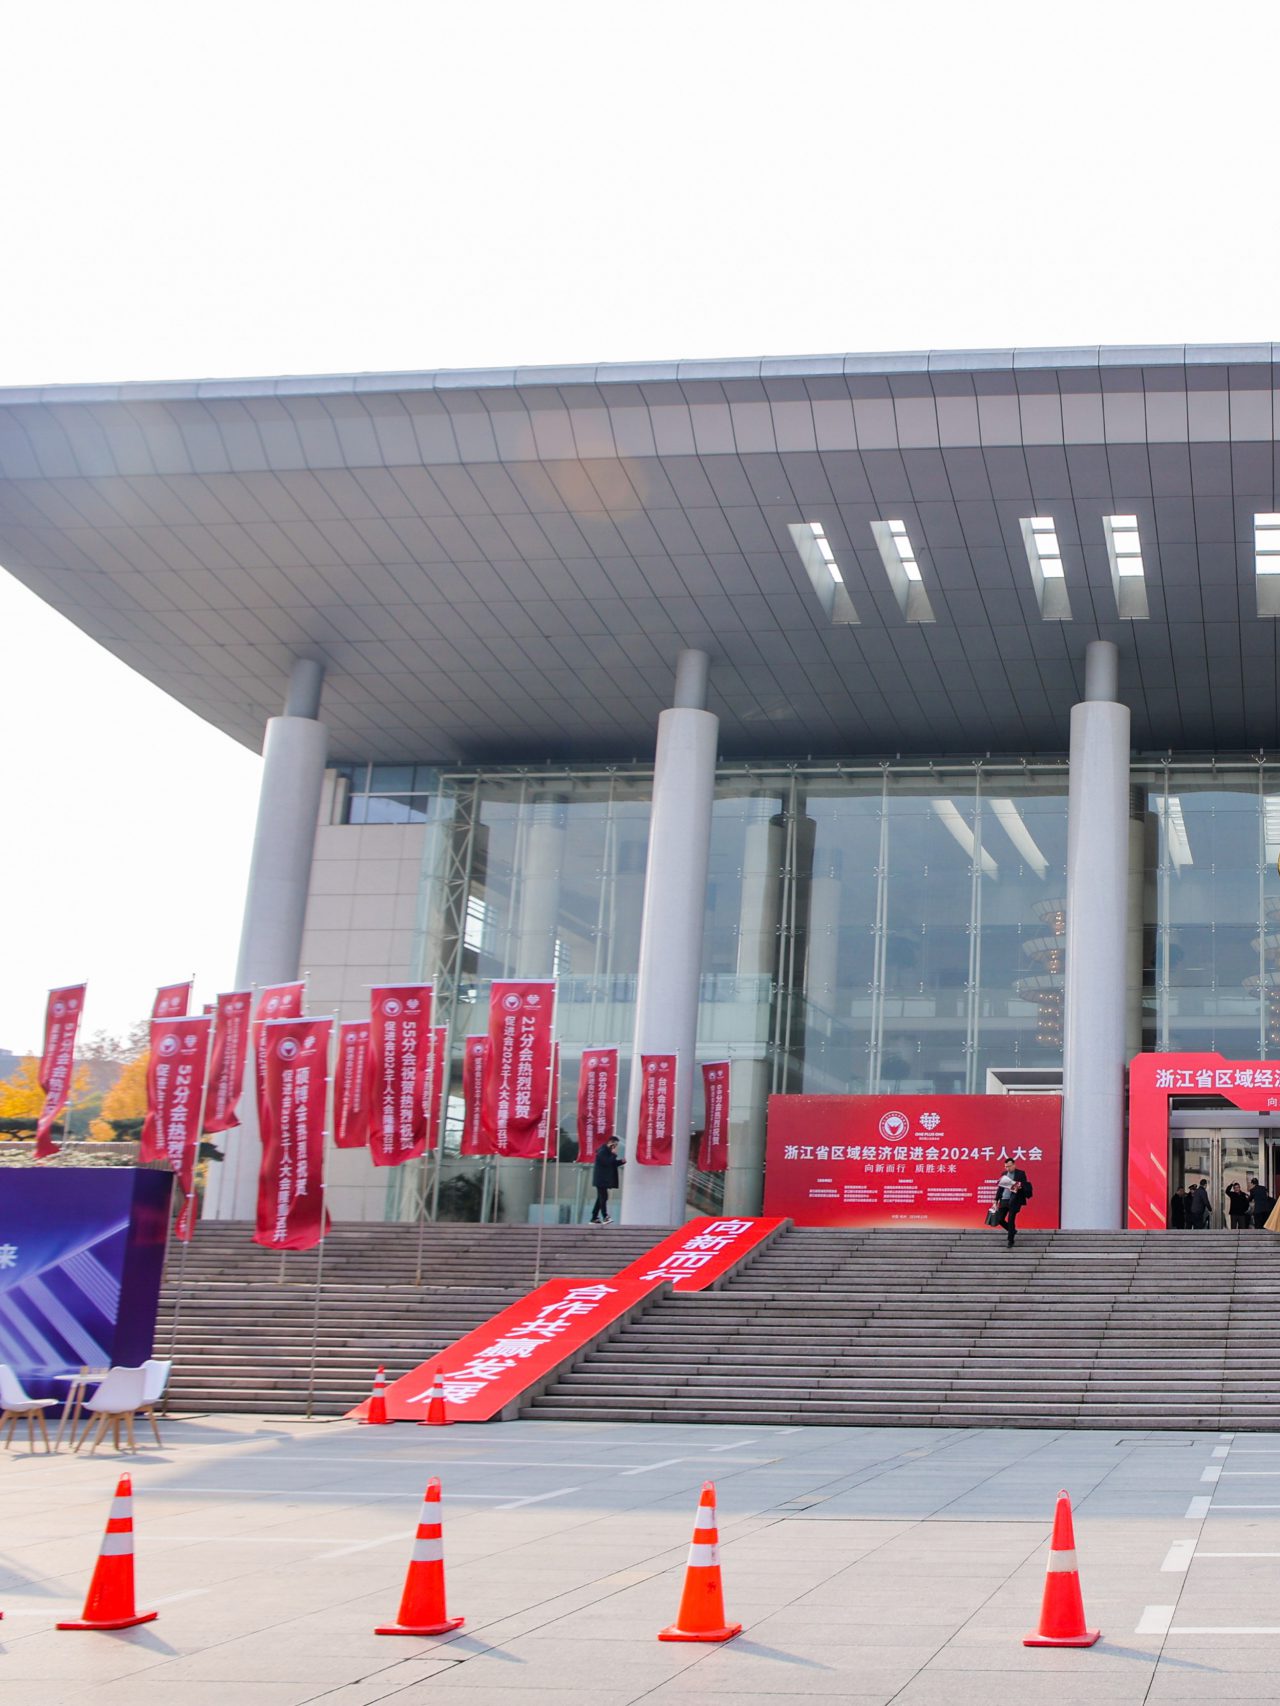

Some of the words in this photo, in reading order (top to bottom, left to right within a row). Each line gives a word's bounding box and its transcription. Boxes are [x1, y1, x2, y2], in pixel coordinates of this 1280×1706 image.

[383, 1021, 397, 1154] 促进会2024千人大会隆重召开
[497, 1016, 516, 1149] 促进会2024千人大会隆重召开
[515, 1016, 536, 1119] 21分会热烈祝贺
[784, 1145, 1043, 1161] 浙江省区域经济促进会2024千人大会
[864, 1163, 906, 1174] 向新而行
[915, 1163, 957, 1173] 质胜未来
[639, 1219, 754, 1284] 向新而行
[406, 1284, 619, 1405] 合作共赢发展
